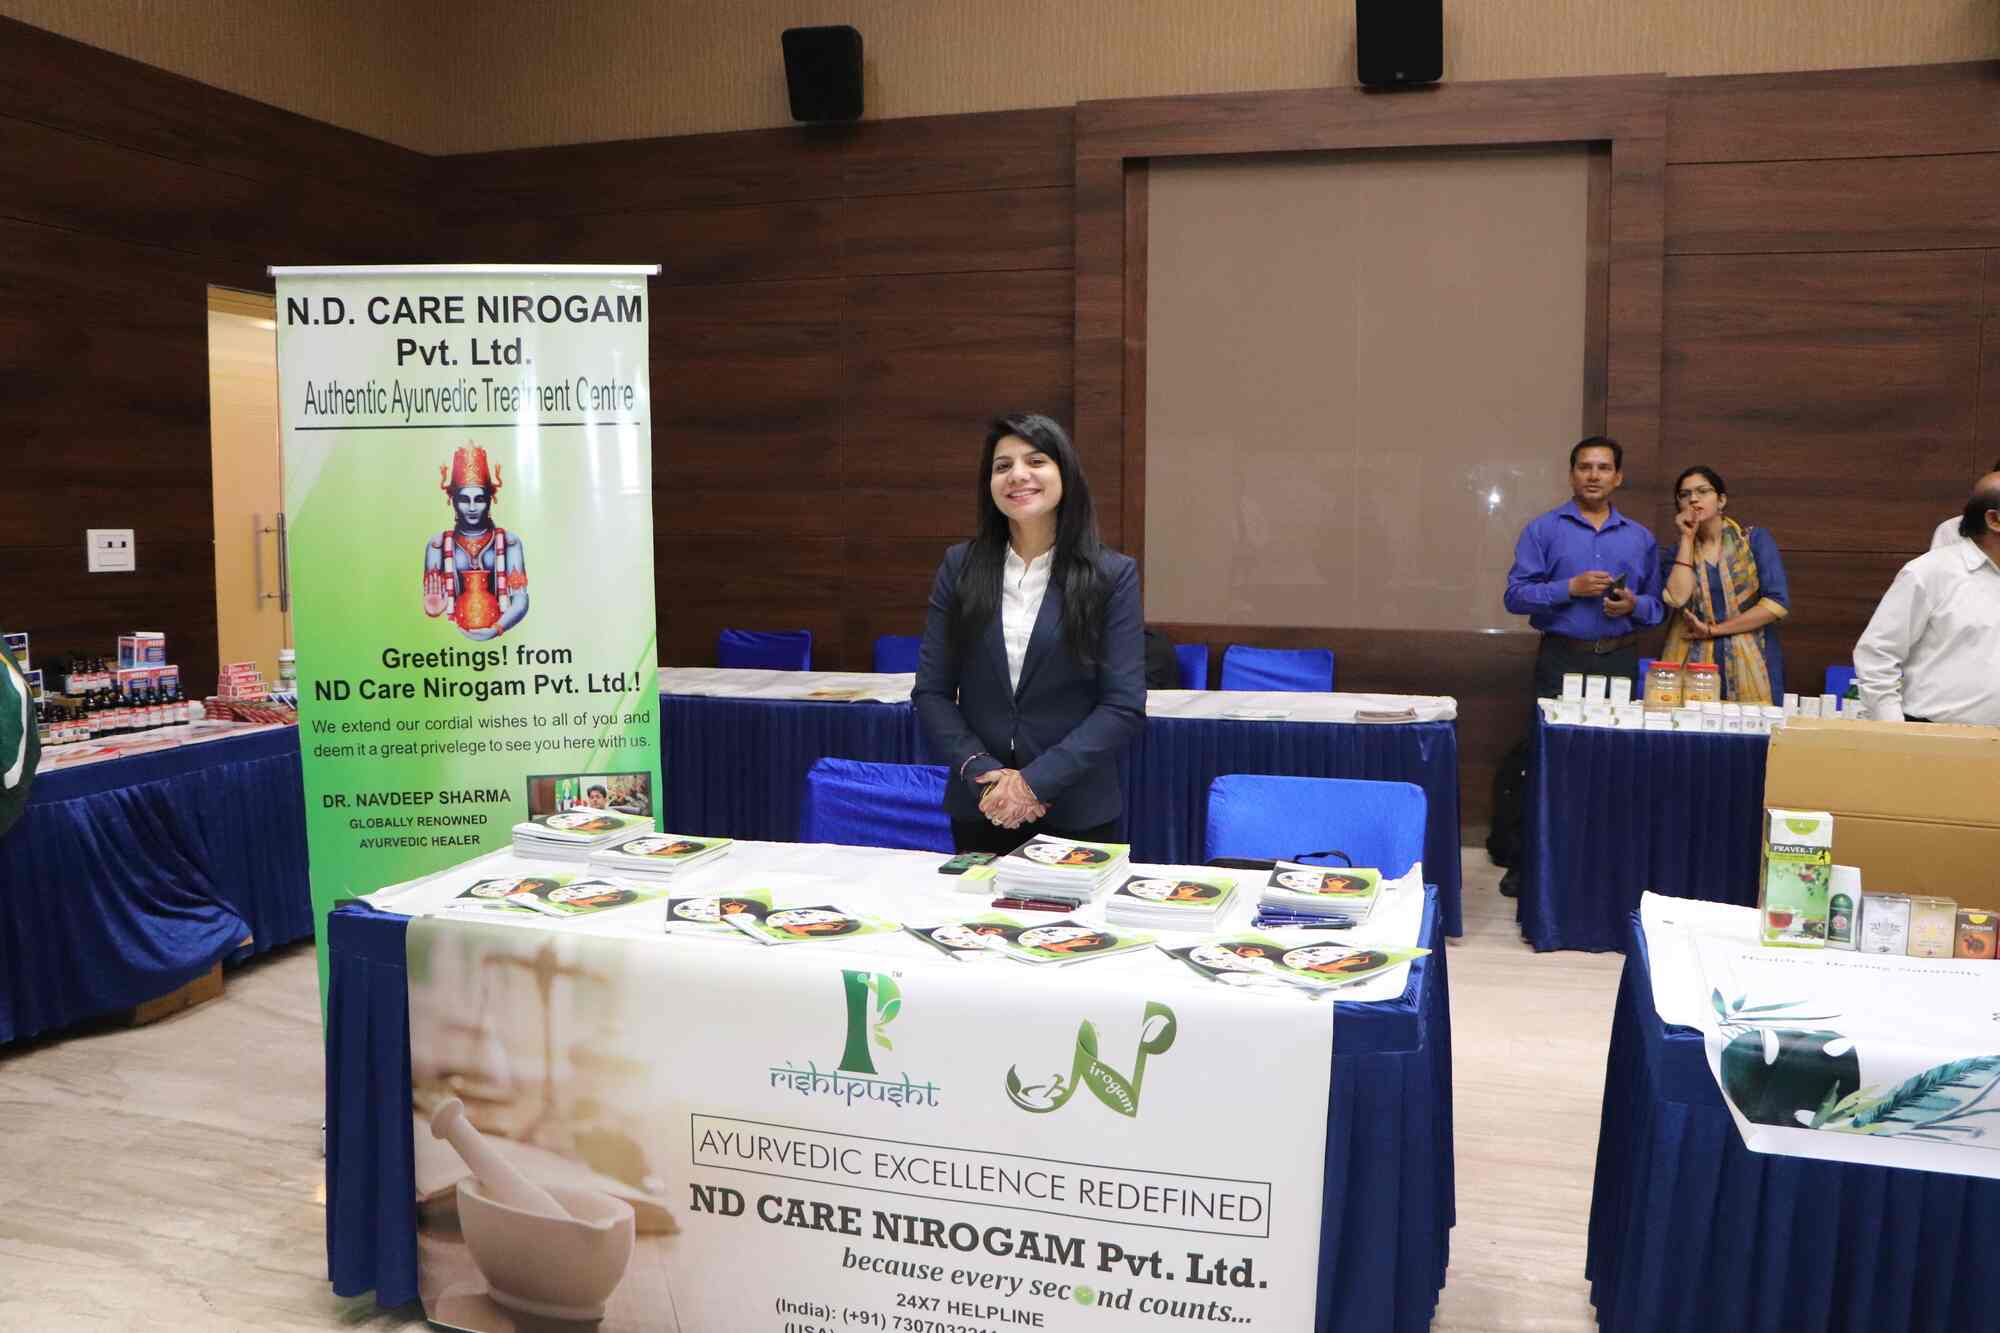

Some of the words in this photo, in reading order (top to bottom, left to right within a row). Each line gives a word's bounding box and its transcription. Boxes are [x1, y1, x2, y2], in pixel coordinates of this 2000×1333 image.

[287, 297, 355, 326] N.D.
[367, 296, 464, 325] CARE
[477, 295, 642, 324] NIROGAM
[397, 338, 458, 366] Pvt.
[471, 337, 532, 366] Ltd.
[304, 380, 387, 416] Authentic
[391, 378, 477, 422] Ayurvedic
[482, 378, 571, 412] Treaent
[576, 376, 634, 412] Centre
[381, 646, 508, 671] Greetings!
[516, 645, 573, 666] from
[315, 680, 350, 701] ND
[359, 678, 415, 699] Care
[423, 677, 525, 701] Nirogam
[534, 674, 580, 695] Pvt.
[588, 672, 641, 693] Ltd.!
[312, 719, 336, 734] We
[341, 718, 391, 733] extend
[396, 720, 420, 732] our
[424, 715, 472, 731] cordial
[478, 714, 527, 730] wishes
[533, 714, 547, 728] to
[552, 712, 568, 727] all
[573, 711, 588, 726] of
[592, 713, 618, 730] you
[623, 710, 650, 725] and
[313, 743, 354, 758] deem
[357, 741, 366, 757] it
[369, 745, 378, 756] a
[380, 741, 417, 758] great
[420, 738, 486, 758] privelege
[489, 738, 503, 753] to
[505, 739, 531, 752] see
[534, 738, 560, 754] you
[563, 735, 595, 751] here
[597, 733, 627, 749] with
[629, 735, 651, 748] us.
[322, 794, 351, 808] DR.
[356, 791, 435, 808] NAVDEEP
[439, 789, 511, 805] SHARMA
[350, 816, 415, 830] GLOBALLY
[417, 814, 488, 828] RENOWNED
[359, 836, 428, 849] AYURVEDIC
[431, 834, 480, 847] HEALER
[700, 1129, 862, 1175] AYURVEDIC
[874, 1153, 1066, 1201] EXCELLENCE
[1079, 1178, 1262, 1223] REDEFINED
[689, 1183, 745, 1217] ND
[756, 1194, 862, 1237] CARE
[872, 1211, 1086, 1269] NIROGAM
[1097, 1241, 1174, 1281] Pvt.
[1186, 1251, 1267, 1289] Ltd.
[842, 1247, 944, 1282] because
[951, 1267, 1023, 1298] every
[1139, 1296, 1252, 1324] counts...
[775, 1297, 836, 1322] (India):
[843, 1308, 887, 1330] (+91)
[896, 1293, 941, 1312] 24X7
[947, 1300, 1045, 1328] HELPLINE
[785, 1322, 834, 1333] (US
